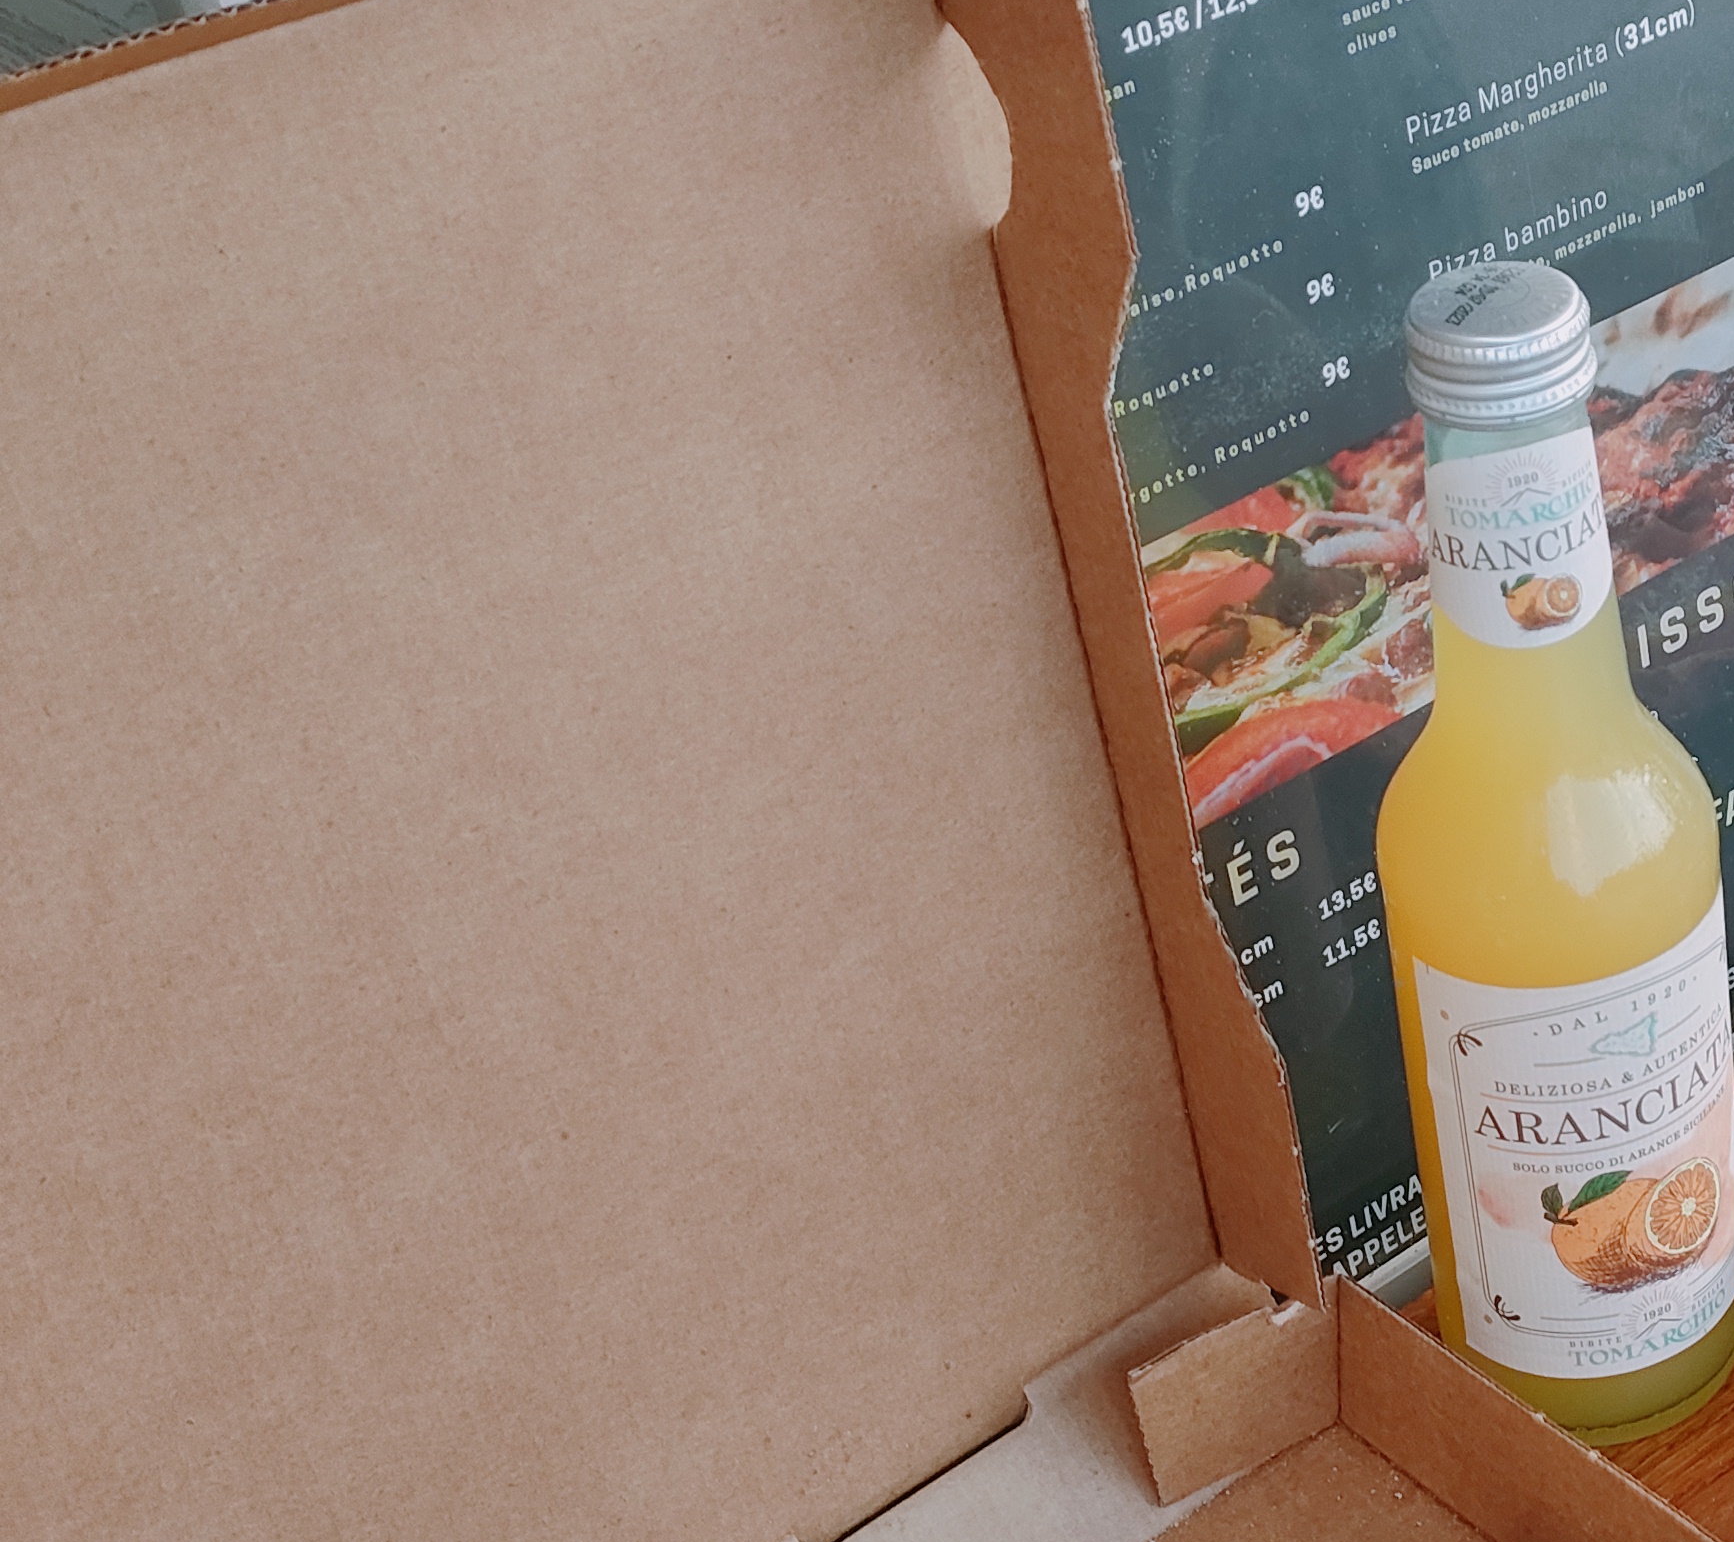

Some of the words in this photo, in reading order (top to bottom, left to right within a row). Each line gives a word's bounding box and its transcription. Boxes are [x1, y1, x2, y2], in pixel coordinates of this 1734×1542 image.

[1121, 5, 1190, 54] 10,5€
[1347, 25, 1397, 56] olives
[1406, 99, 1471, 144] Pizza
[1478, 42, 1608, 114] Margherita
[1411, 141, 1460, 175] Sauce
[1463, 117, 1525, 152] tomate,
[1528, 81, 1607, 126] mozzarella
[1295, 185, 1325, 217] 9€
[1555, 212, 1641, 261] mozzarella,
[1649, 180, 1705, 220] jambon
[1428, 240, 1496, 279] Pizza
[1504, 189, 1607, 251] bambino
[1306, 272, 1335, 304] 9€
[1114, 363, 1214, 418] Roquette
[1322, 355, 1351, 387] 9€
[1214, 410, 1310, 464] Roquette
[1445, 470, 1594, 530] TOMARCHIO
[1507, 471, 1539, 489] 1920
[1318, 872, 1377, 920] 13,5€
[1322, 918, 1381, 967] 11,5€
[1549, 1013, 1608, 1037] DAL
[1632, 979, 1686, 1012] 1920
[1495, 1081, 1612, 1097] DELIZIOSA
[1621, 1072, 1634, 1084] &
[1642, 1003, 1722, 1077] AUTENTICA
[1475, 1019, 1731, 1146] ARANCIATA
[1513, 1162, 1550, 1174] SOLO
[1555, 1162, 1604, 1174] SUCCO
[1609, 1156, 1625, 1167] DI
[1628, 1131, 1681, 1163] ARANCE
[1568, 1289, 1726, 1367] TOMARCHIO
[1643, 1303, 1672, 1322] 1920
